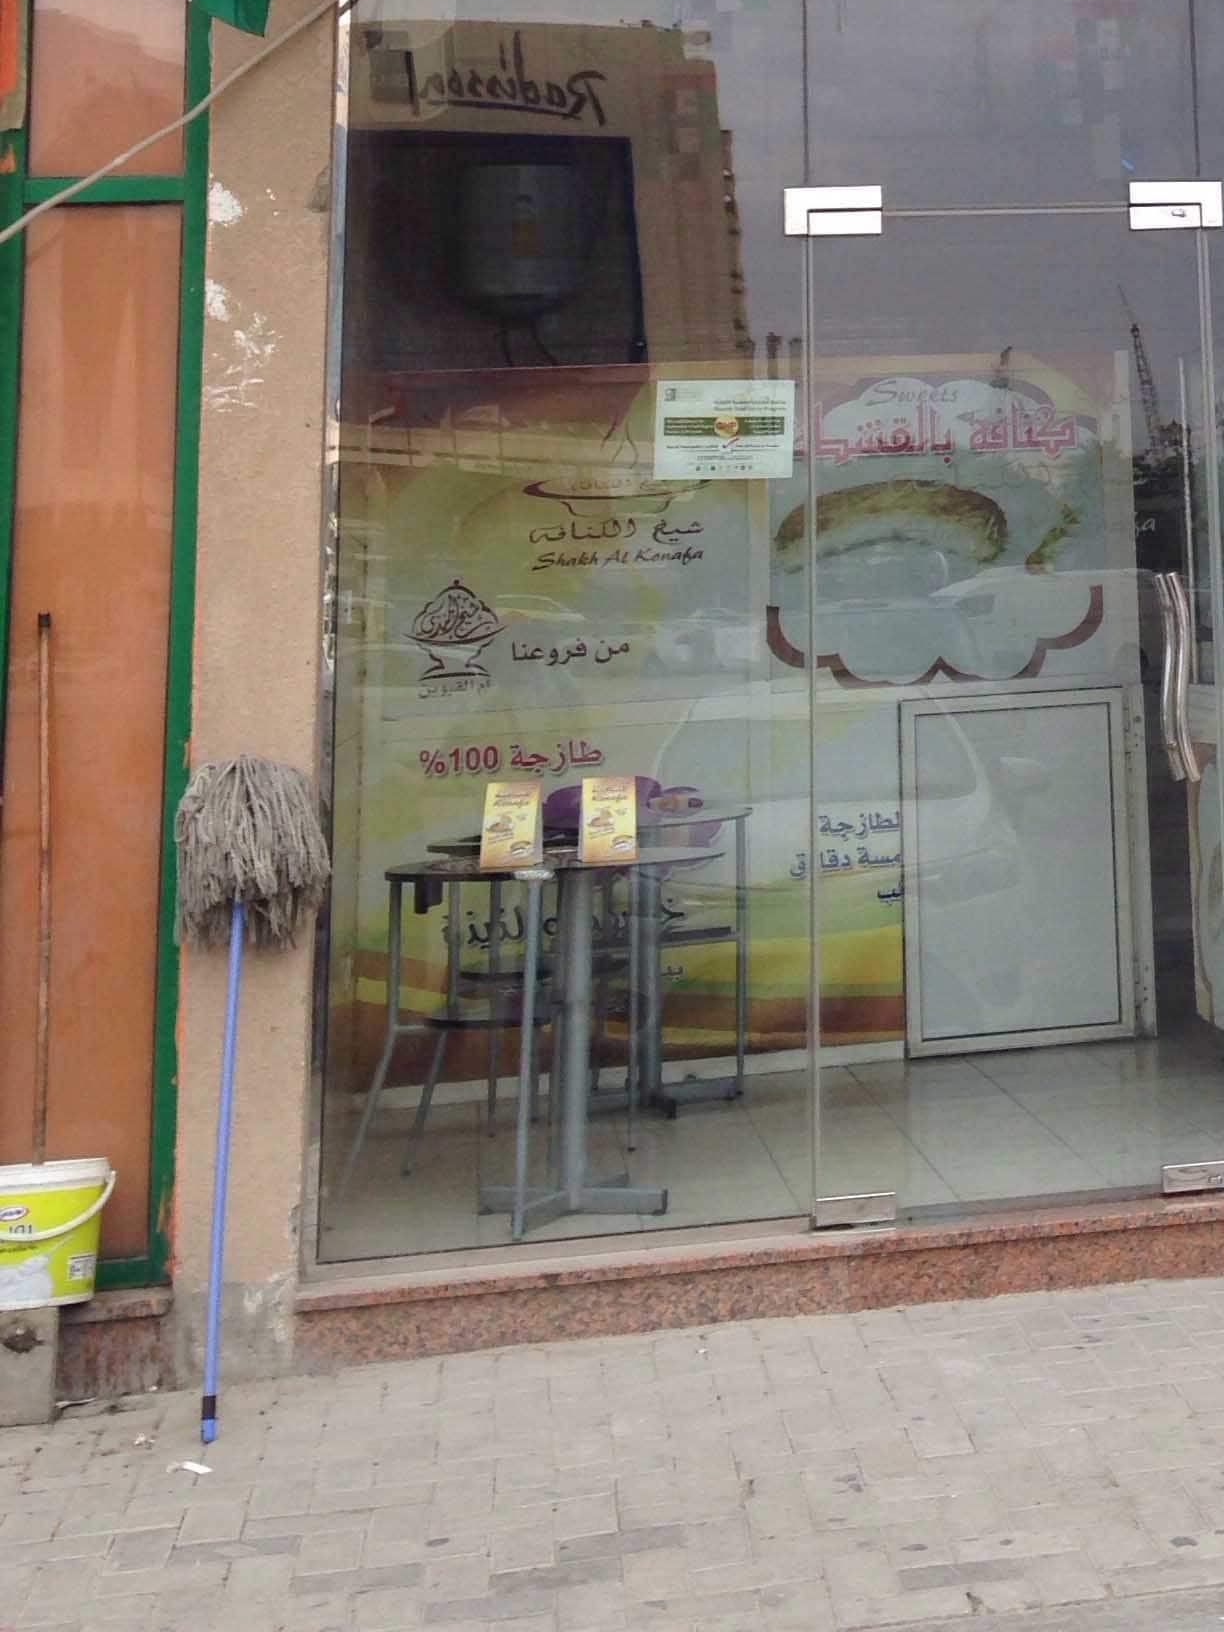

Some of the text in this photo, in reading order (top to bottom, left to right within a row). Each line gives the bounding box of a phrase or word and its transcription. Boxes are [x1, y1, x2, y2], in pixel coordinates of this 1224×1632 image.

[866, 379, 958, 407] Sweets
[651, 518, 705, 546] شيخ
[531, 546, 705, 572] Shakh Al Konafa
[510, 637, 631, 667] من فروعنا
[509, 739, 604, 775] طازجة
[818, 811, 900, 839] لطازجة
